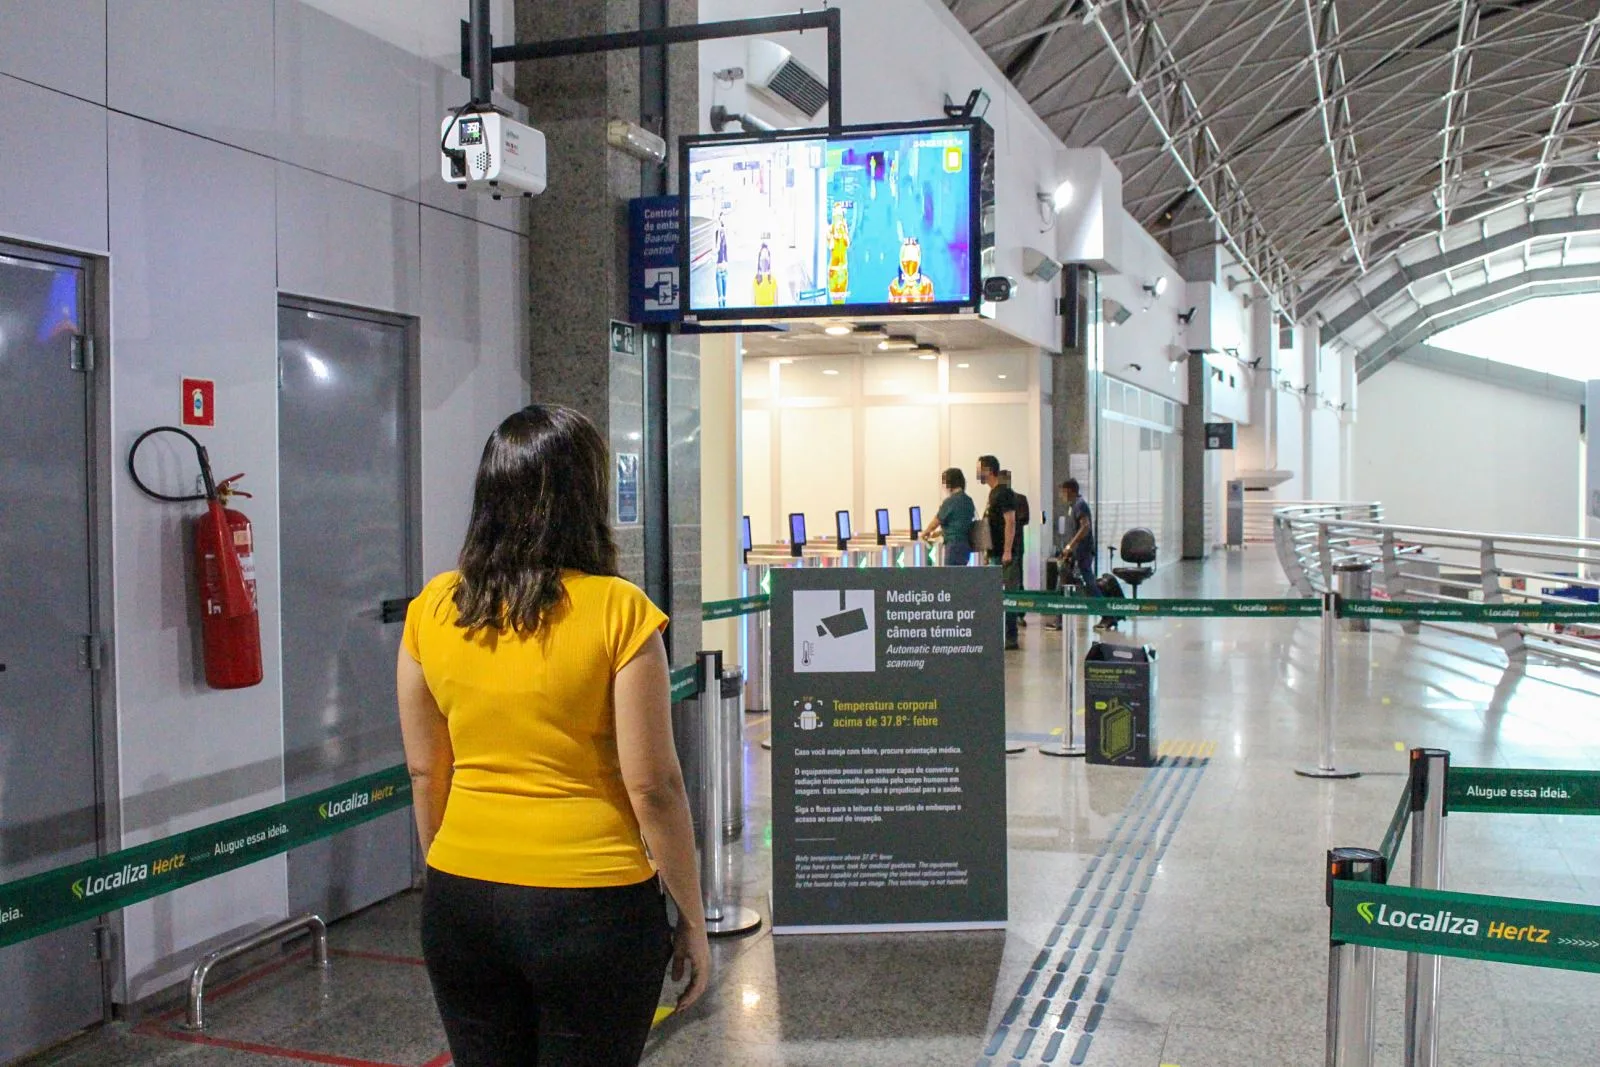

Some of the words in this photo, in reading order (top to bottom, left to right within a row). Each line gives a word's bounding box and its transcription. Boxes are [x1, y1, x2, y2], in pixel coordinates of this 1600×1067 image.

[644, 222, 654, 231] de
[643, 245, 675, 256] control
[886, 590, 934, 605] Medição
[937, 590, 951, 603] de
[1112, 603, 1140, 611] Localiza
[1238, 604, 1268, 612] Localiza
[1354, 604, 1384, 614] Localiza
[1489, 609, 1520, 617] Localiza
[886, 609, 953, 623] temperatura
[957, 610, 975, 622] por
[886, 626, 927, 639] câmera
[930, 626, 972, 638] térmica
[886, 644, 930, 655] Automatic
[932, 644, 983, 656] temperature
[886, 658, 925, 671] scanning
[832, 699, 894, 713] Temperatura
[897, 699, 937, 713] corporal
[833, 715, 863, 728] acima
[866, 715, 878, 727] de
[913, 714, 938, 727] febre
[811, 747, 825, 756] você
[827, 747, 846, 757] esteja
[880, 748, 904, 756] procure
[905, 747, 937, 756] orientação
[938, 746, 962, 754] médica.
[801, 768, 841, 777] equipamento
[842, 768, 863, 776] possui
[794, 778, 822, 786] radiação
[822, 777, 865, 785] infravermelha
[794, 788, 821, 796] imagem.
[822, 787, 837, 795] Esta
[838, 786, 870, 796] tecnologia
[871, 786, 883, 794] não
[889, 786, 922, 795] prejudicial
[1466, 785, 1507, 800] Alugue
[1510, 788, 1537, 798] essa
[1540, 786, 1571, 799] ideia.
[327, 791, 369, 818] Localiza
[370, 784, 395, 803] Hertz
[794, 805, 809, 814] Siga
[816, 805, 831, 813] fluxo
[852, 804, 873, 812] leitura
[895, 804, 915, 812] cartão
[926, 804, 957, 812] embarque
[826, 814, 844, 822] canal
[85, 863, 148, 897] Localiza
[152, 851, 186, 876] Hertz
[213, 836, 245, 858] Alugue
[246, 830, 266, 846] essa
[267, 823, 290, 842] ideia.
[1377, 903, 1479, 936] Localiza
[1487, 921, 1552, 944] Hertz
